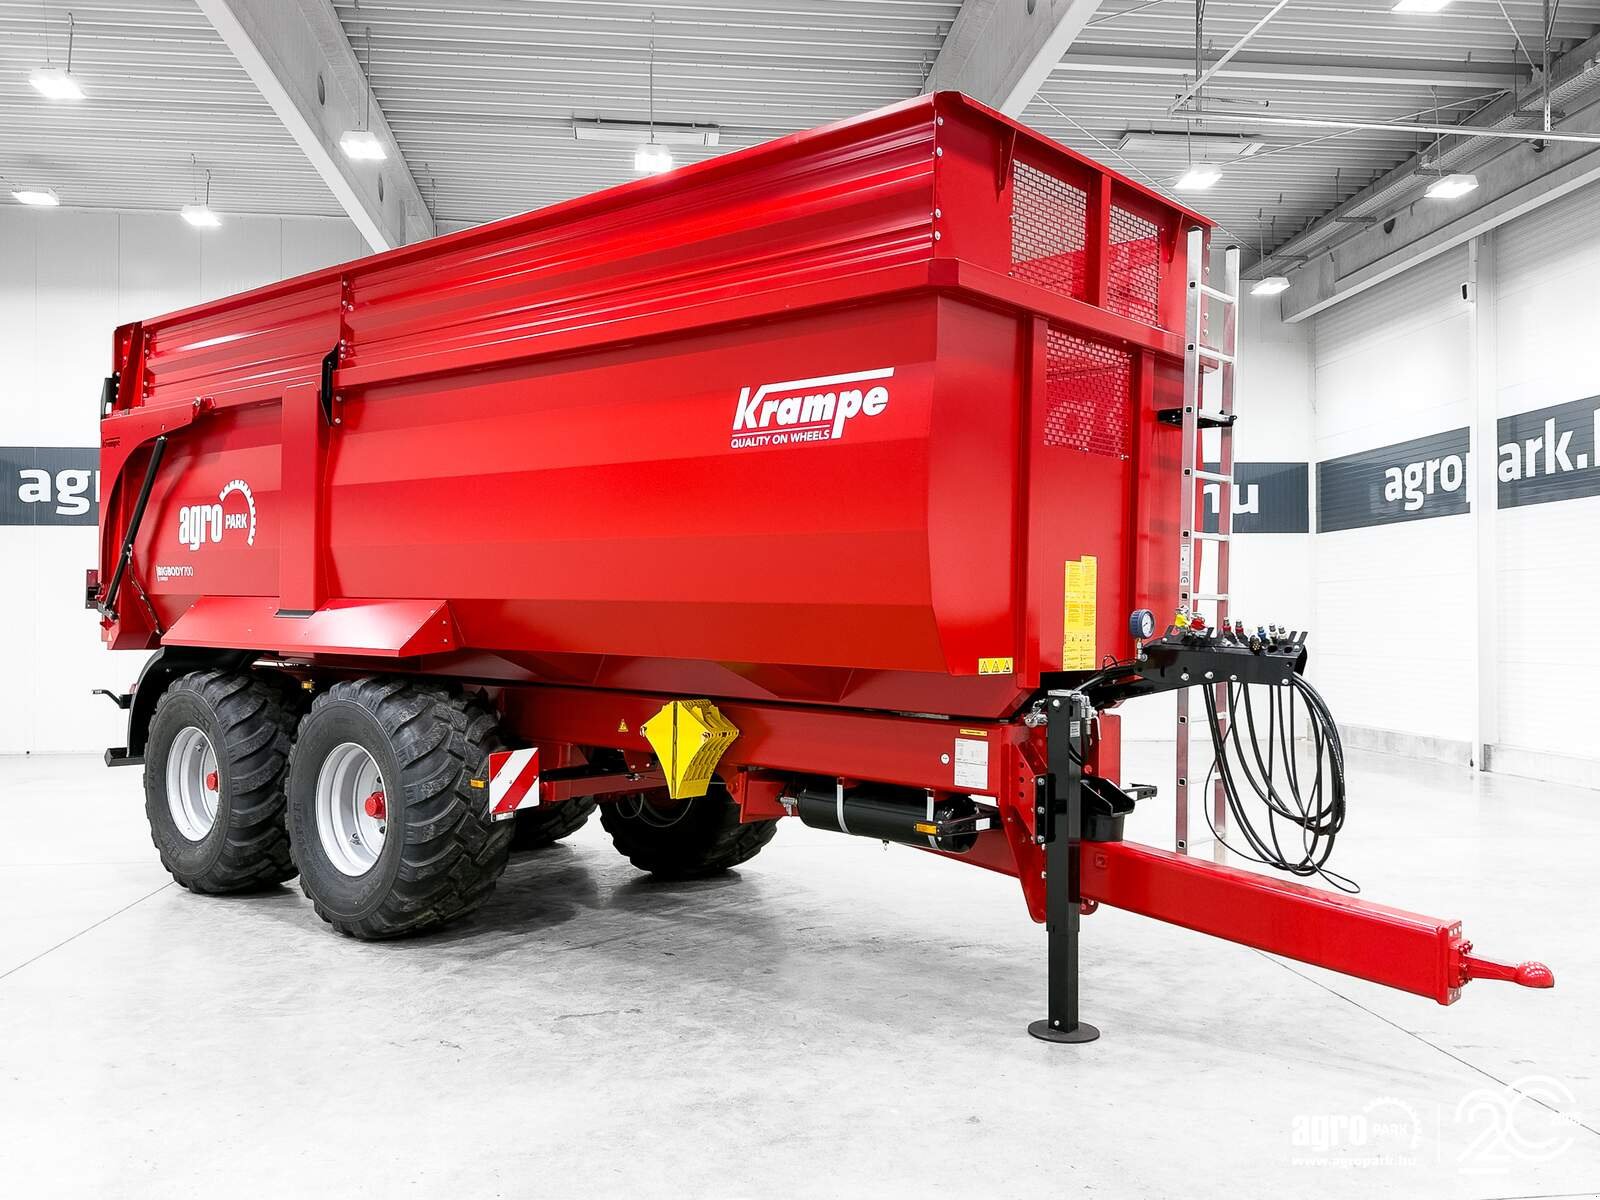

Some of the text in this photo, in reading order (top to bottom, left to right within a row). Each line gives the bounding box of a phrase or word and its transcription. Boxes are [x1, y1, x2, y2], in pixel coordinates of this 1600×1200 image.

[733, 367, 895, 441] Krampe
[731, 429, 830, 449] QUALITY ON WHEELS
[1384, 452, 1470, 511] agro
[178, 502, 247, 551] agro PARK
